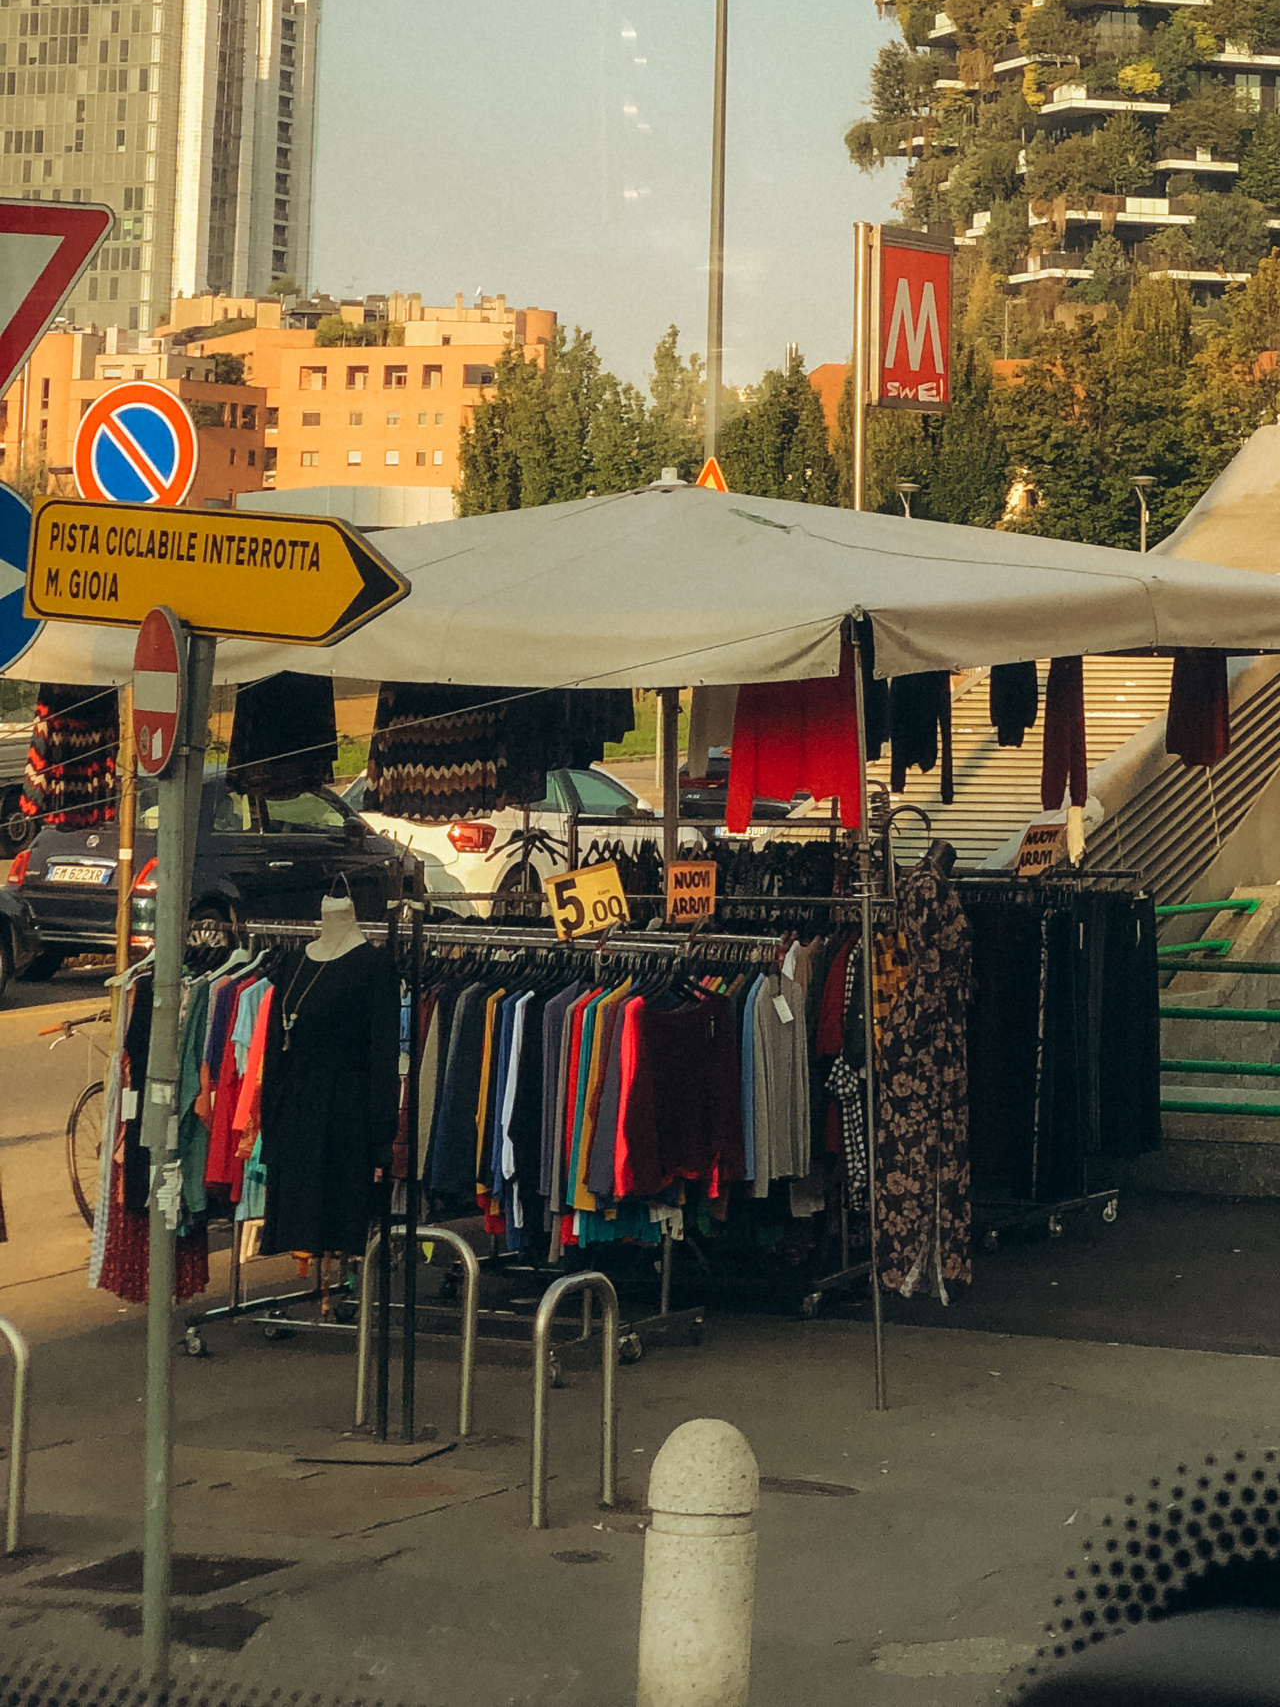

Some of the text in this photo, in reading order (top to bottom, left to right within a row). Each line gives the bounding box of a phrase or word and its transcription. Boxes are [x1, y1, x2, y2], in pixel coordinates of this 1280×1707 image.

[884, 278, 945, 374] M
[49, 522, 320, 572] PISTA CICLABILE INTERROTTA
[45, 567, 119, 602] M. GIOIA
[673, 870, 711, 890] NUOVI
[554, 878, 623, 931] 5,00
[672, 896, 711, 916] ARRIVI
